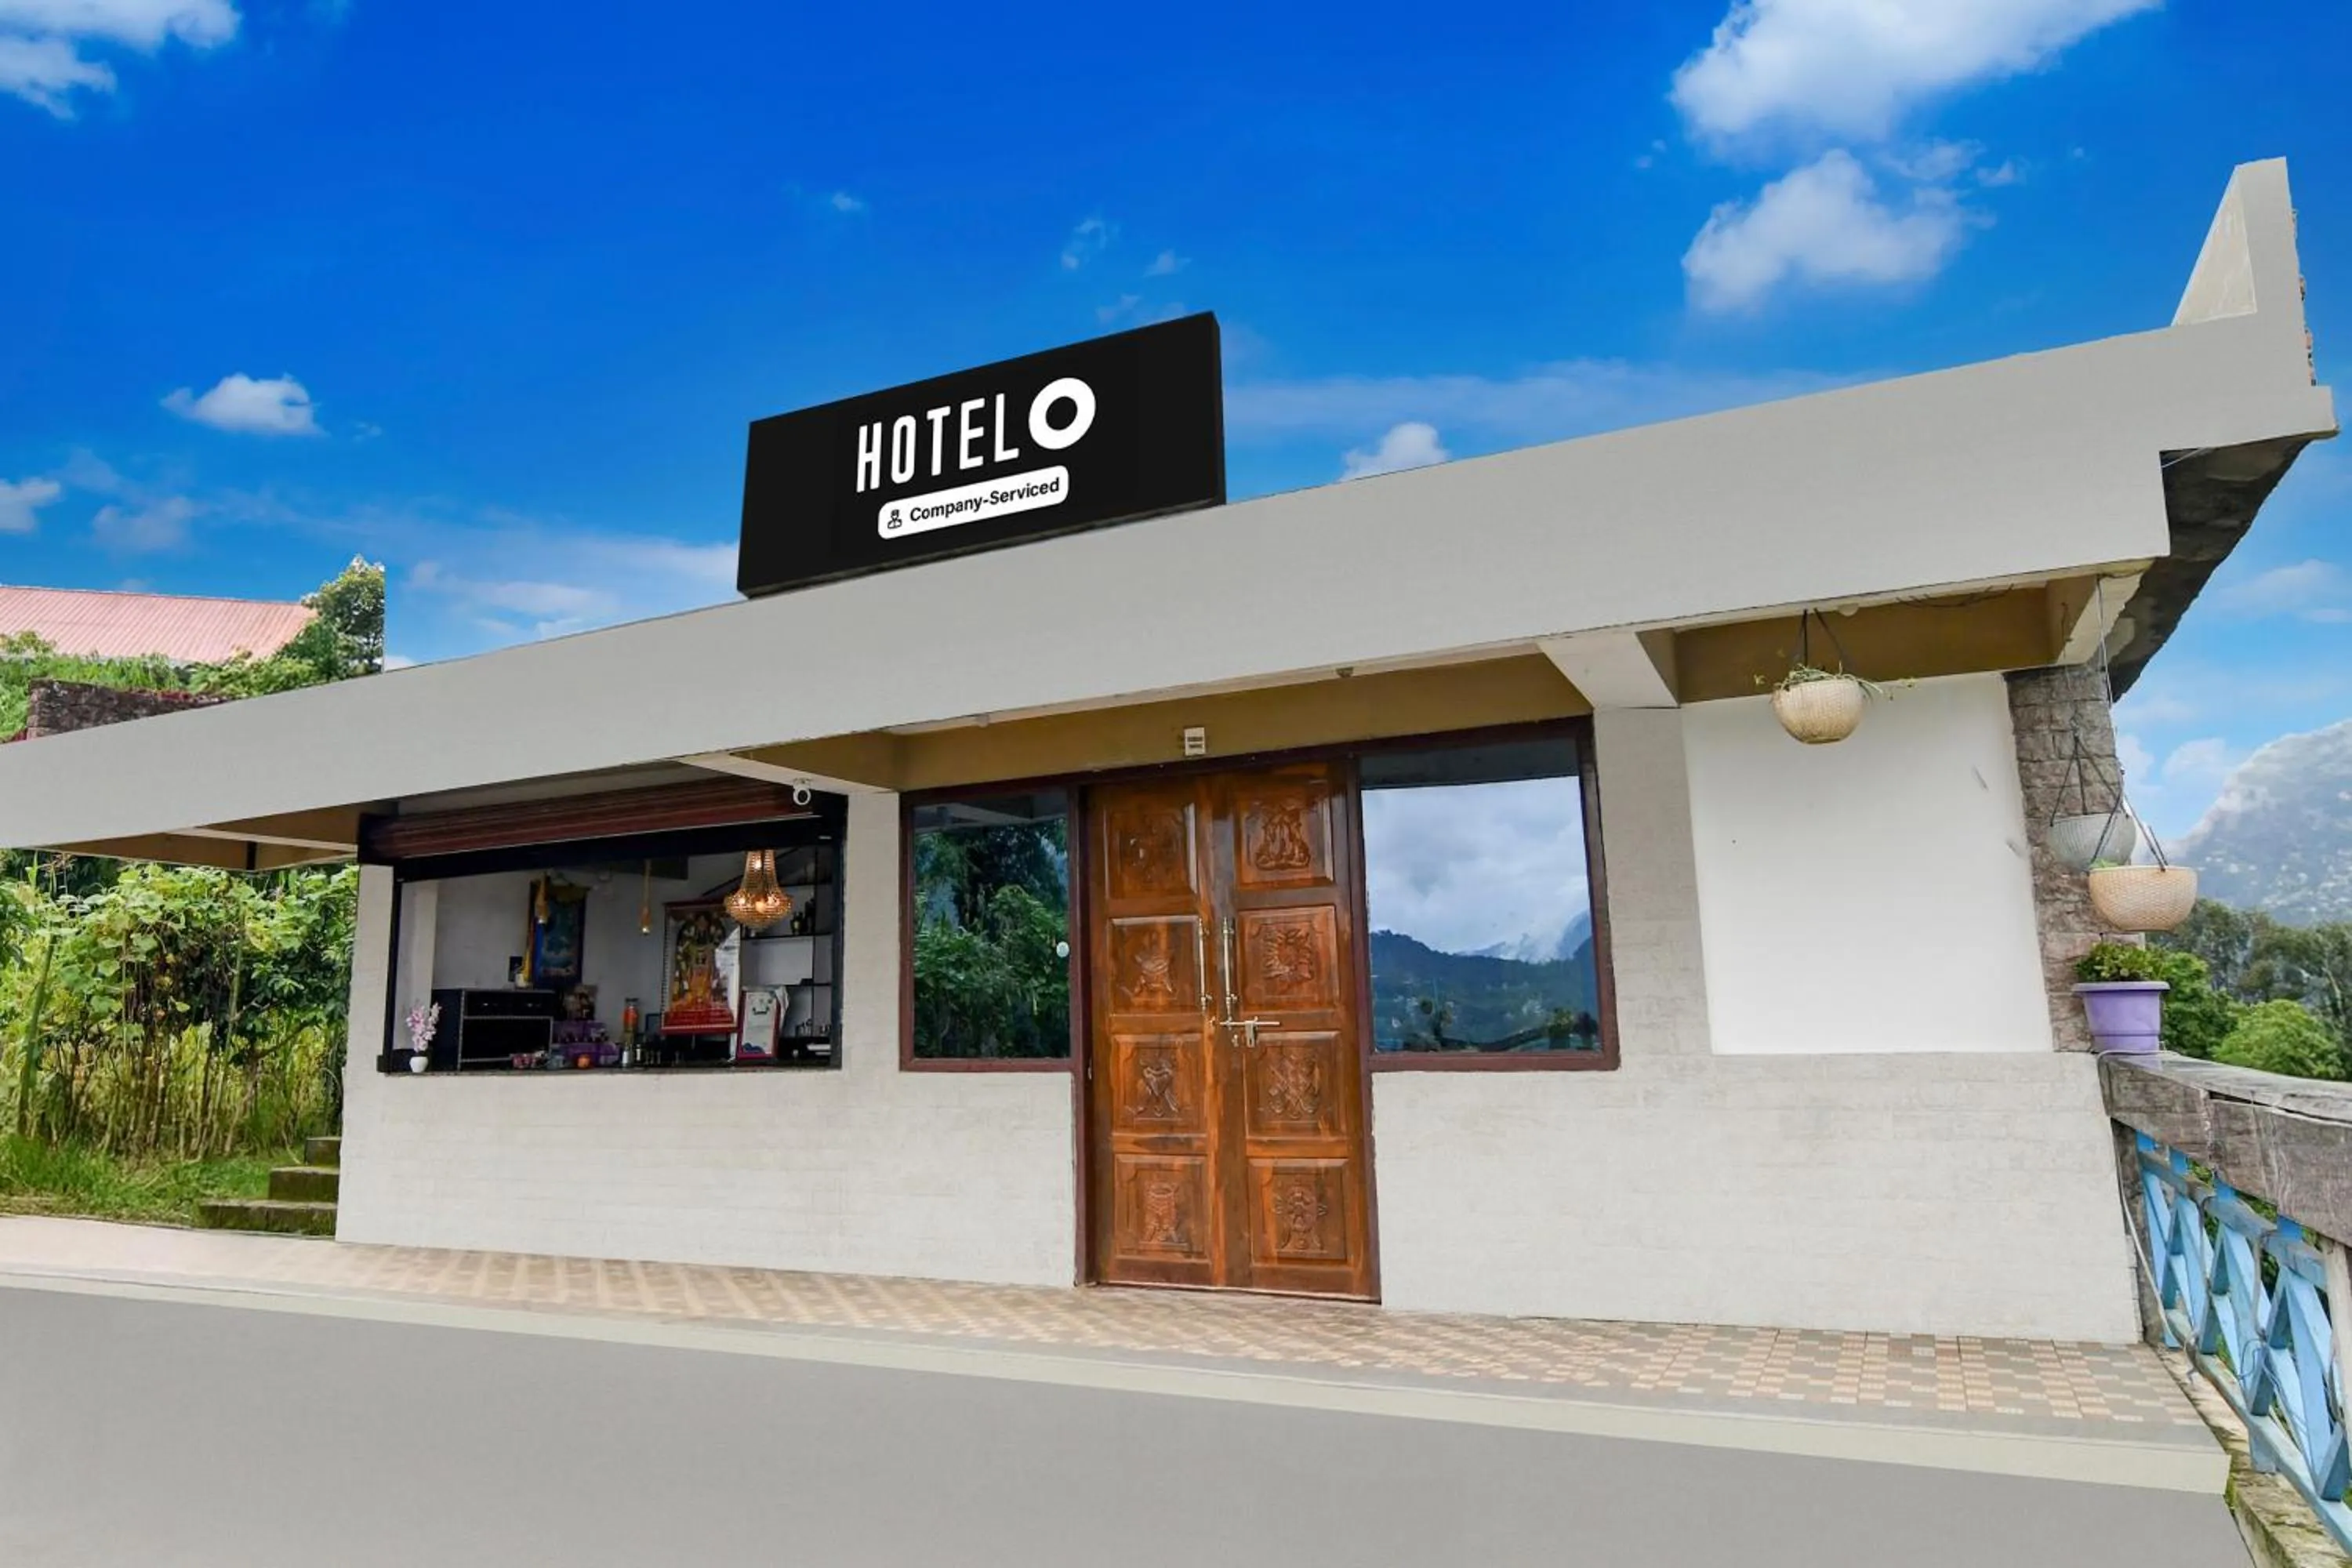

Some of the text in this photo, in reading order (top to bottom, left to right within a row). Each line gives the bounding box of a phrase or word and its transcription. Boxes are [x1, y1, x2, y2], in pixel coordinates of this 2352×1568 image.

[856, 377, 1096, 493] HOTEL O
[909, 477, 1060, 521] Company-Serviced
